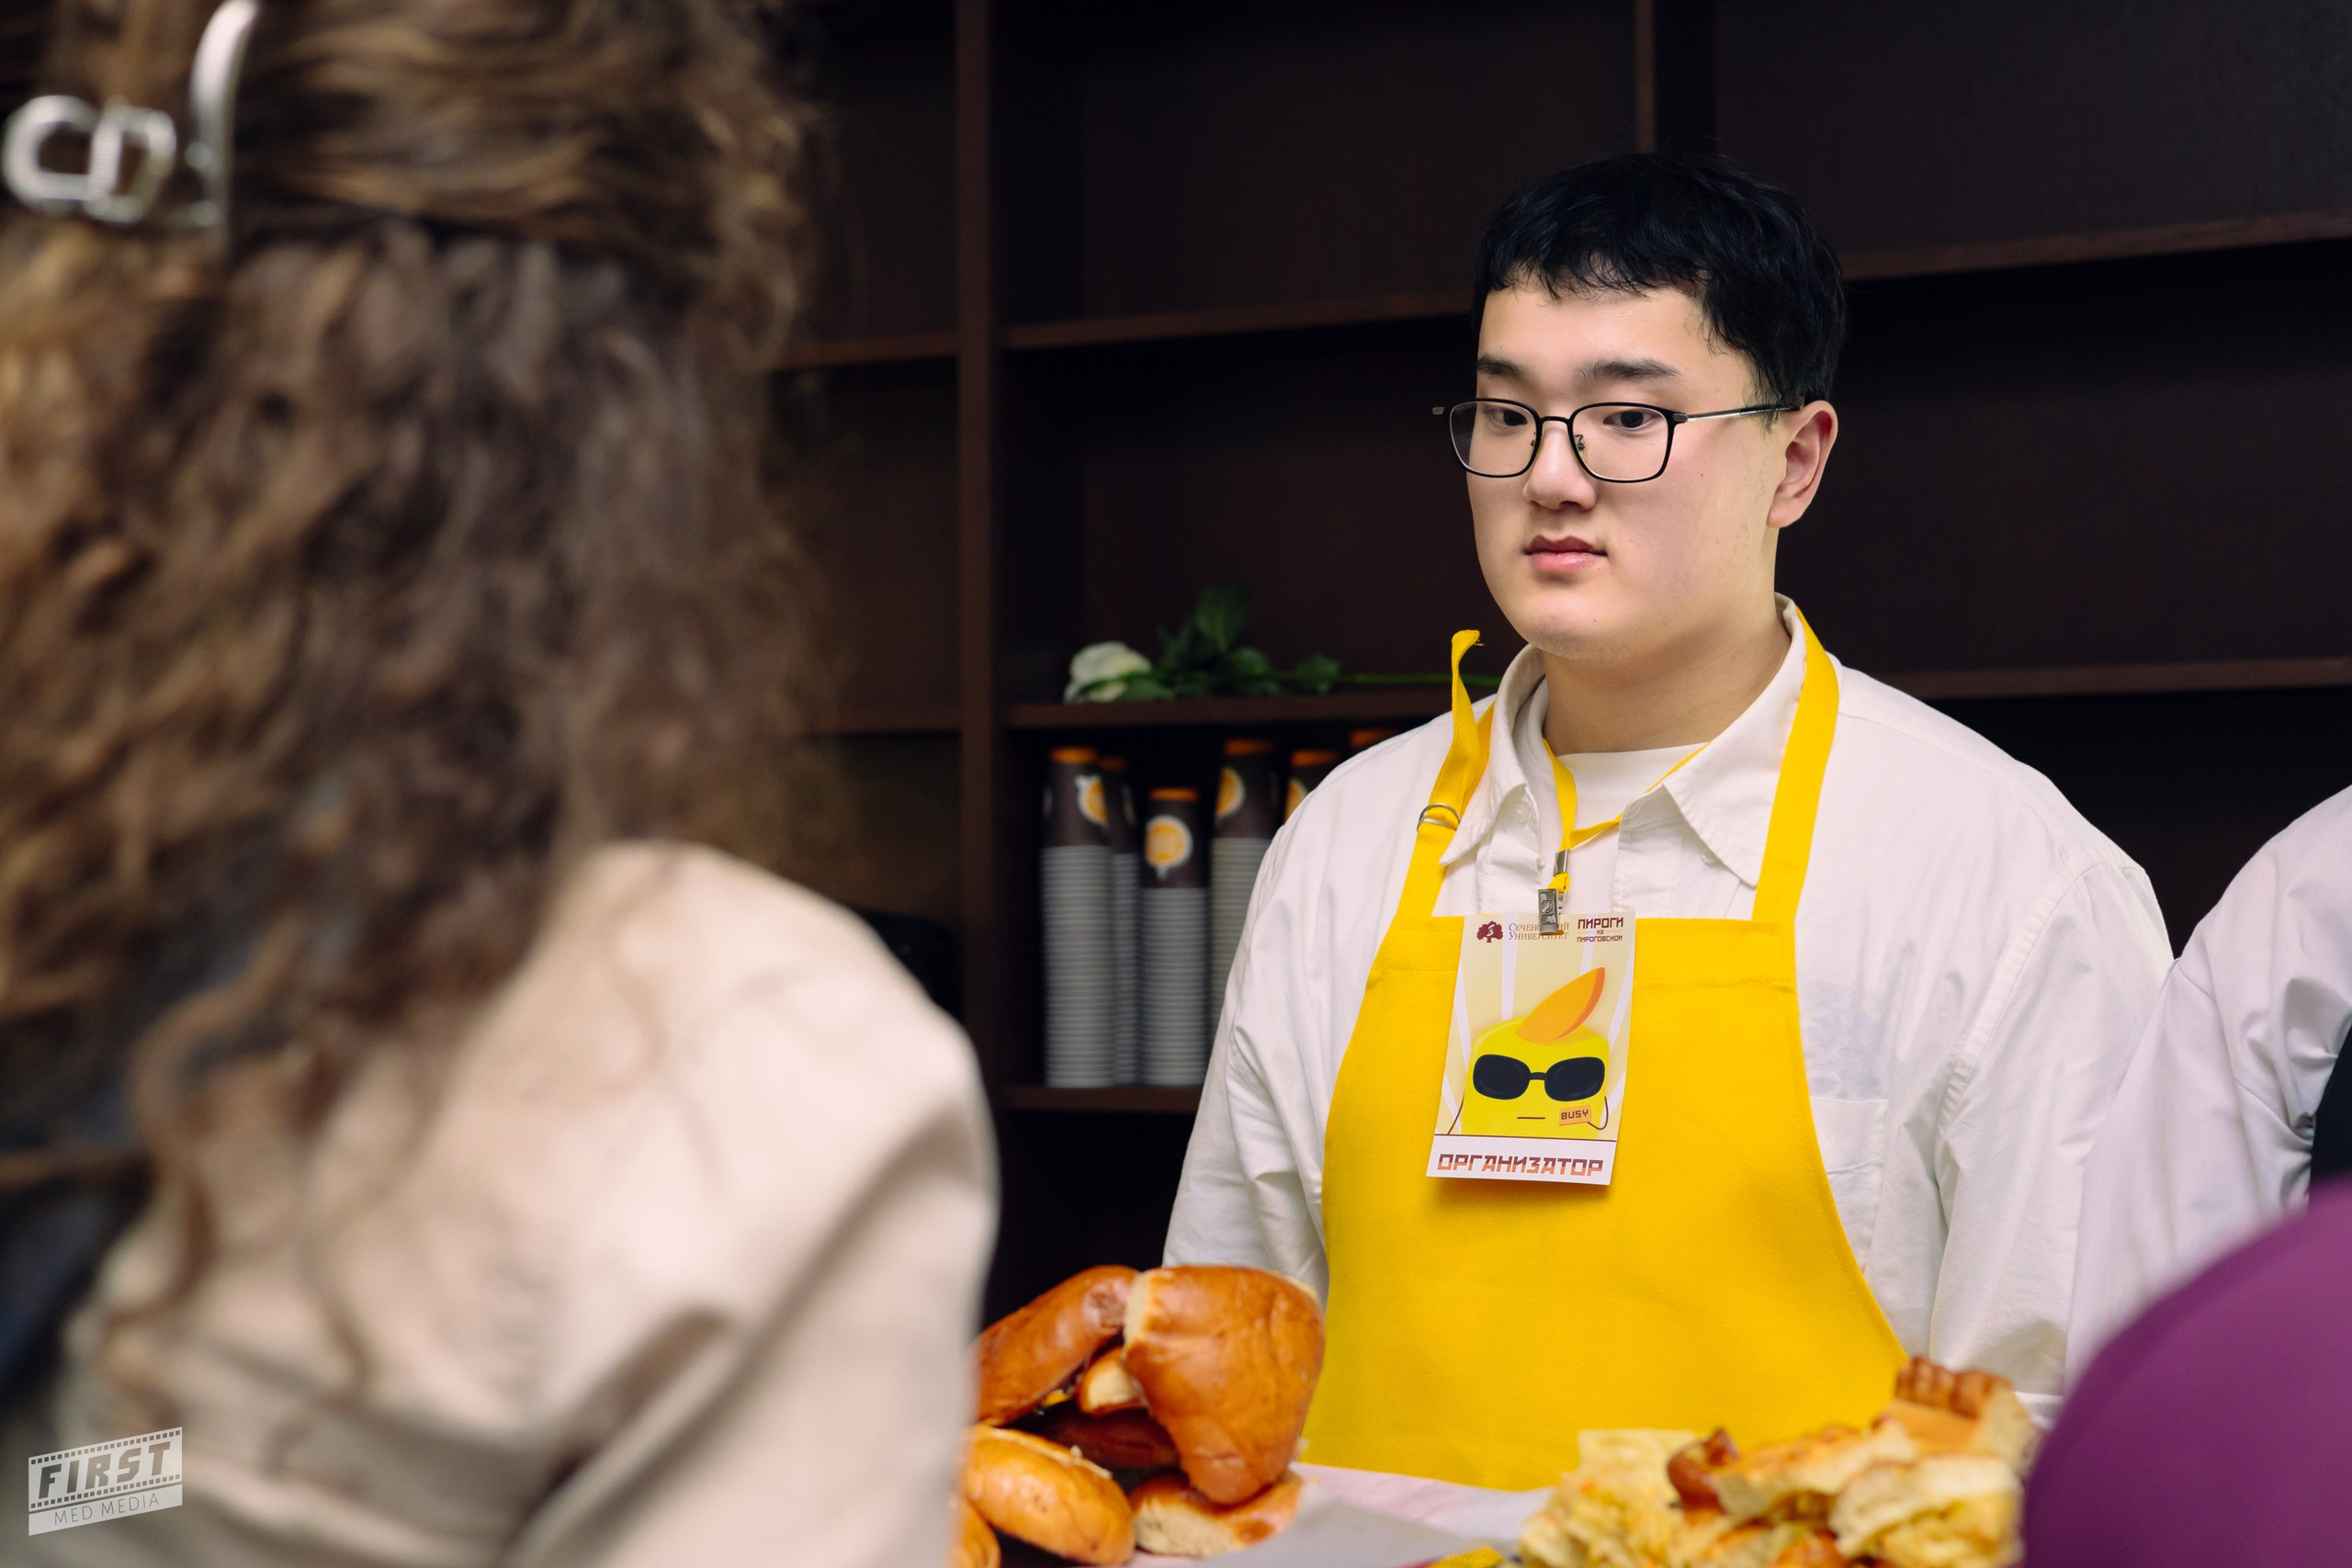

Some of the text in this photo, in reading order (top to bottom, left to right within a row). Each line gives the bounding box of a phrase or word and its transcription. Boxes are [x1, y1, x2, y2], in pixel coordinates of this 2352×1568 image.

[1509, 921, 1569, 931] СЕЧЕНИЙ
[1577, 917, 1623, 929] ПИРОГИ
[1561, 1109, 1589, 1120] BUSY
[1437, 1154, 1603, 1176] ОРГАНИЗАТОР
